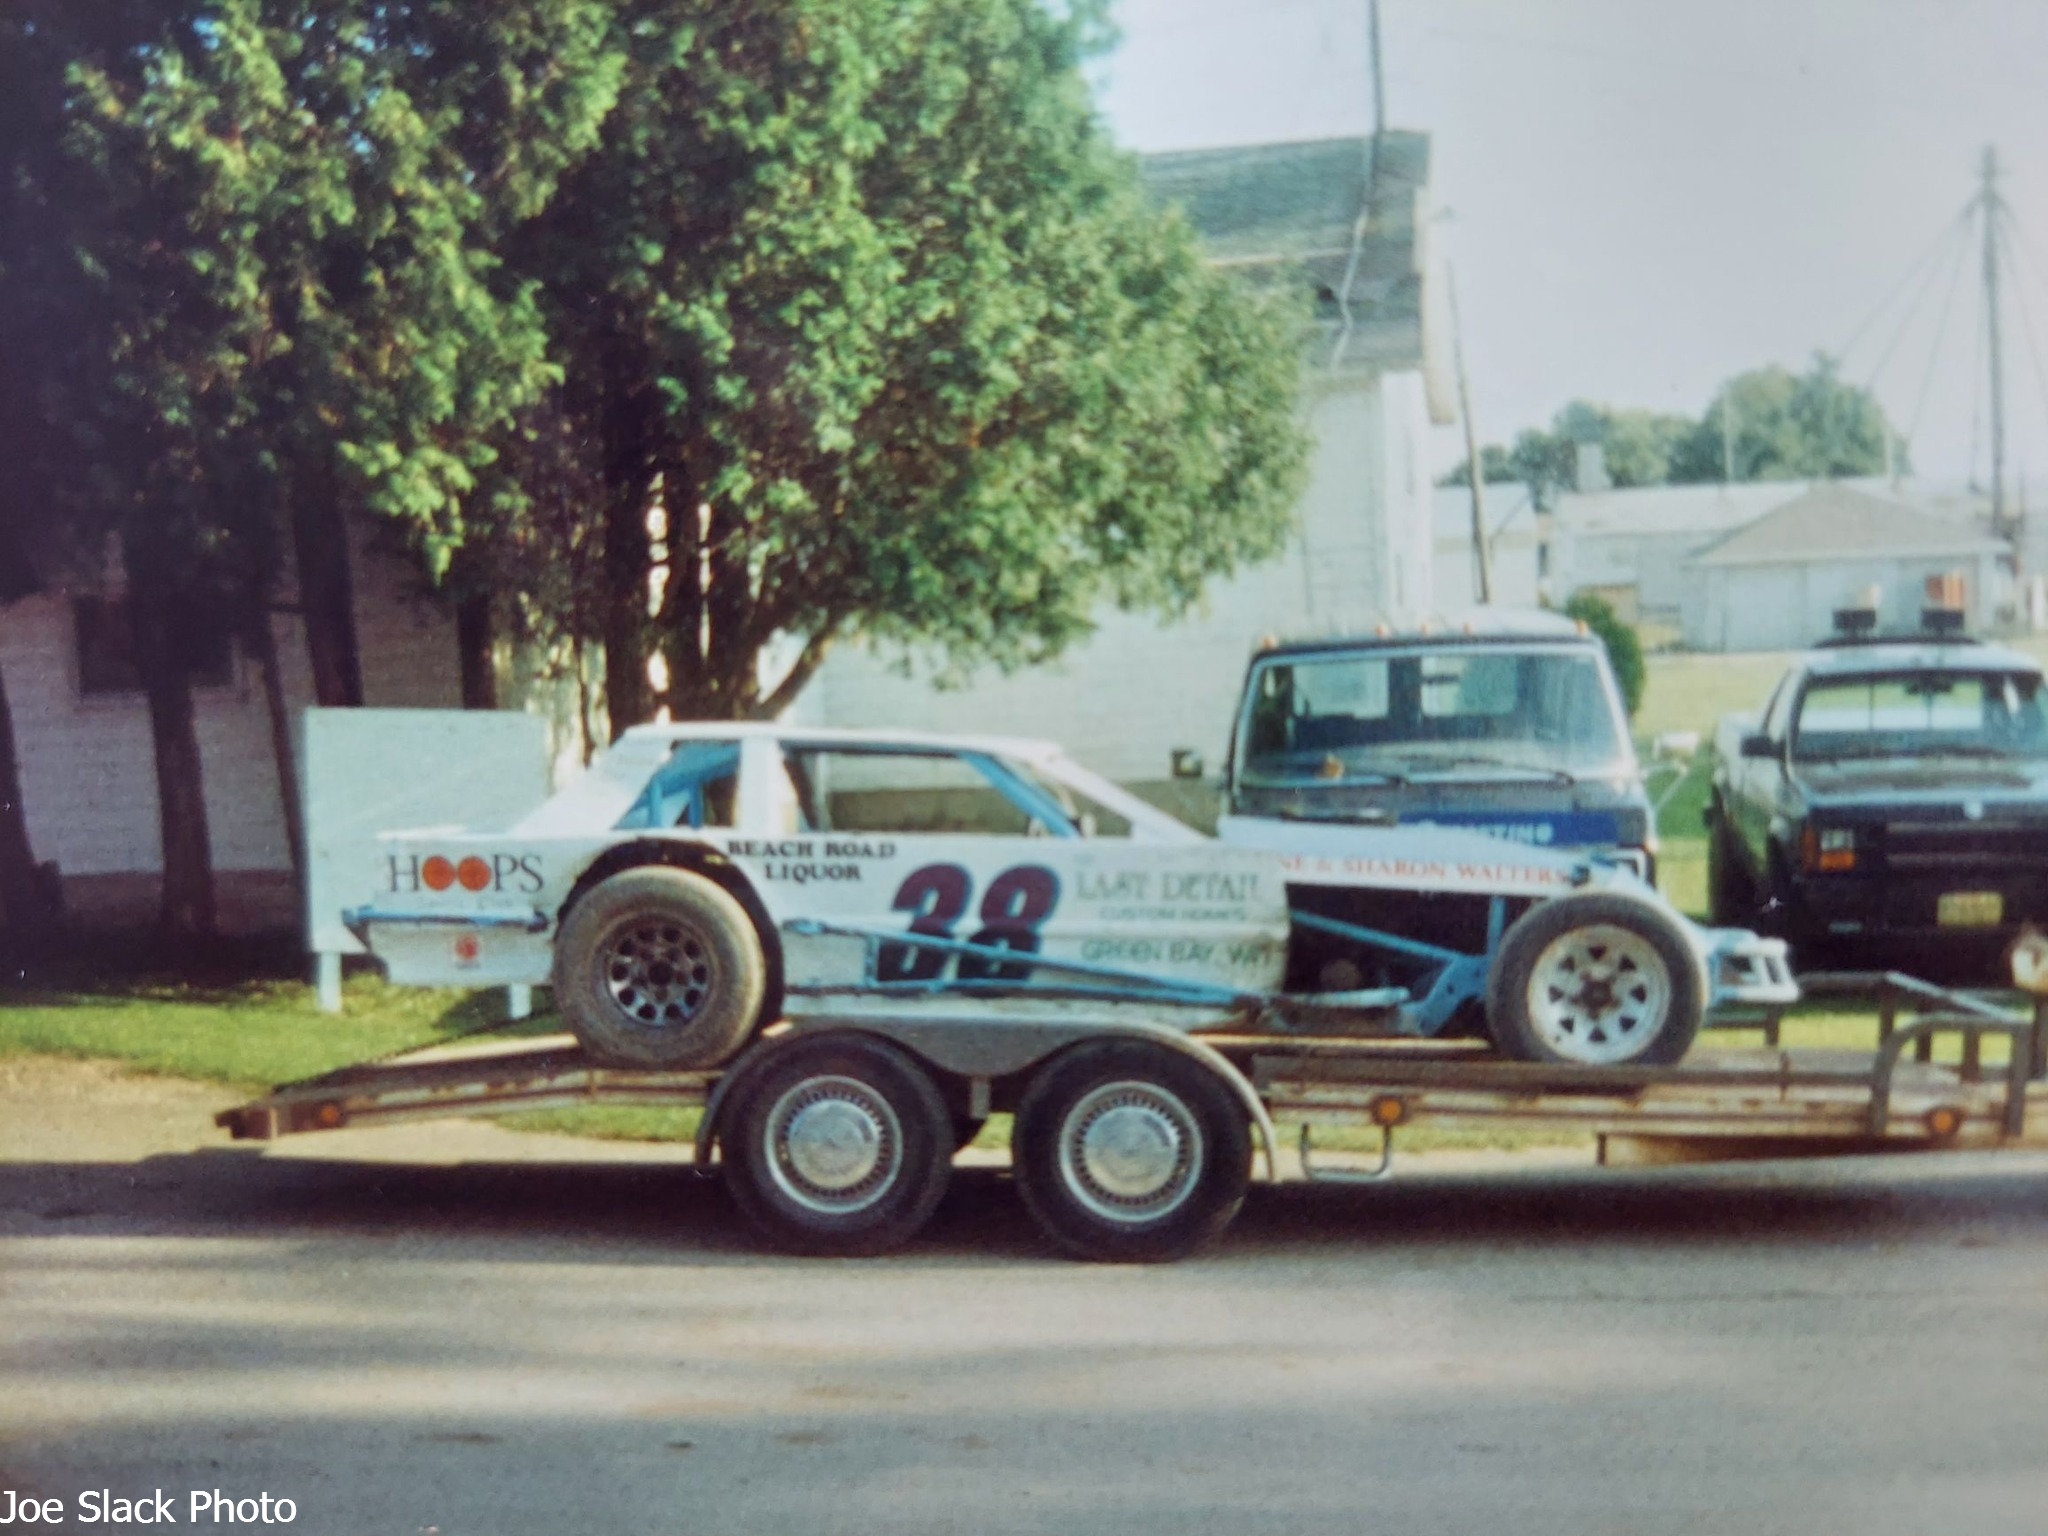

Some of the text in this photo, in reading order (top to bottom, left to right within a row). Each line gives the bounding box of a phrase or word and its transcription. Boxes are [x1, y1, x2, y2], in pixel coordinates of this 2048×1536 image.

[728, 840, 896, 858] BEACH ROAD
[765, 863, 862, 883] LIQUOR
[1343, 857, 1445, 880] SHARON
